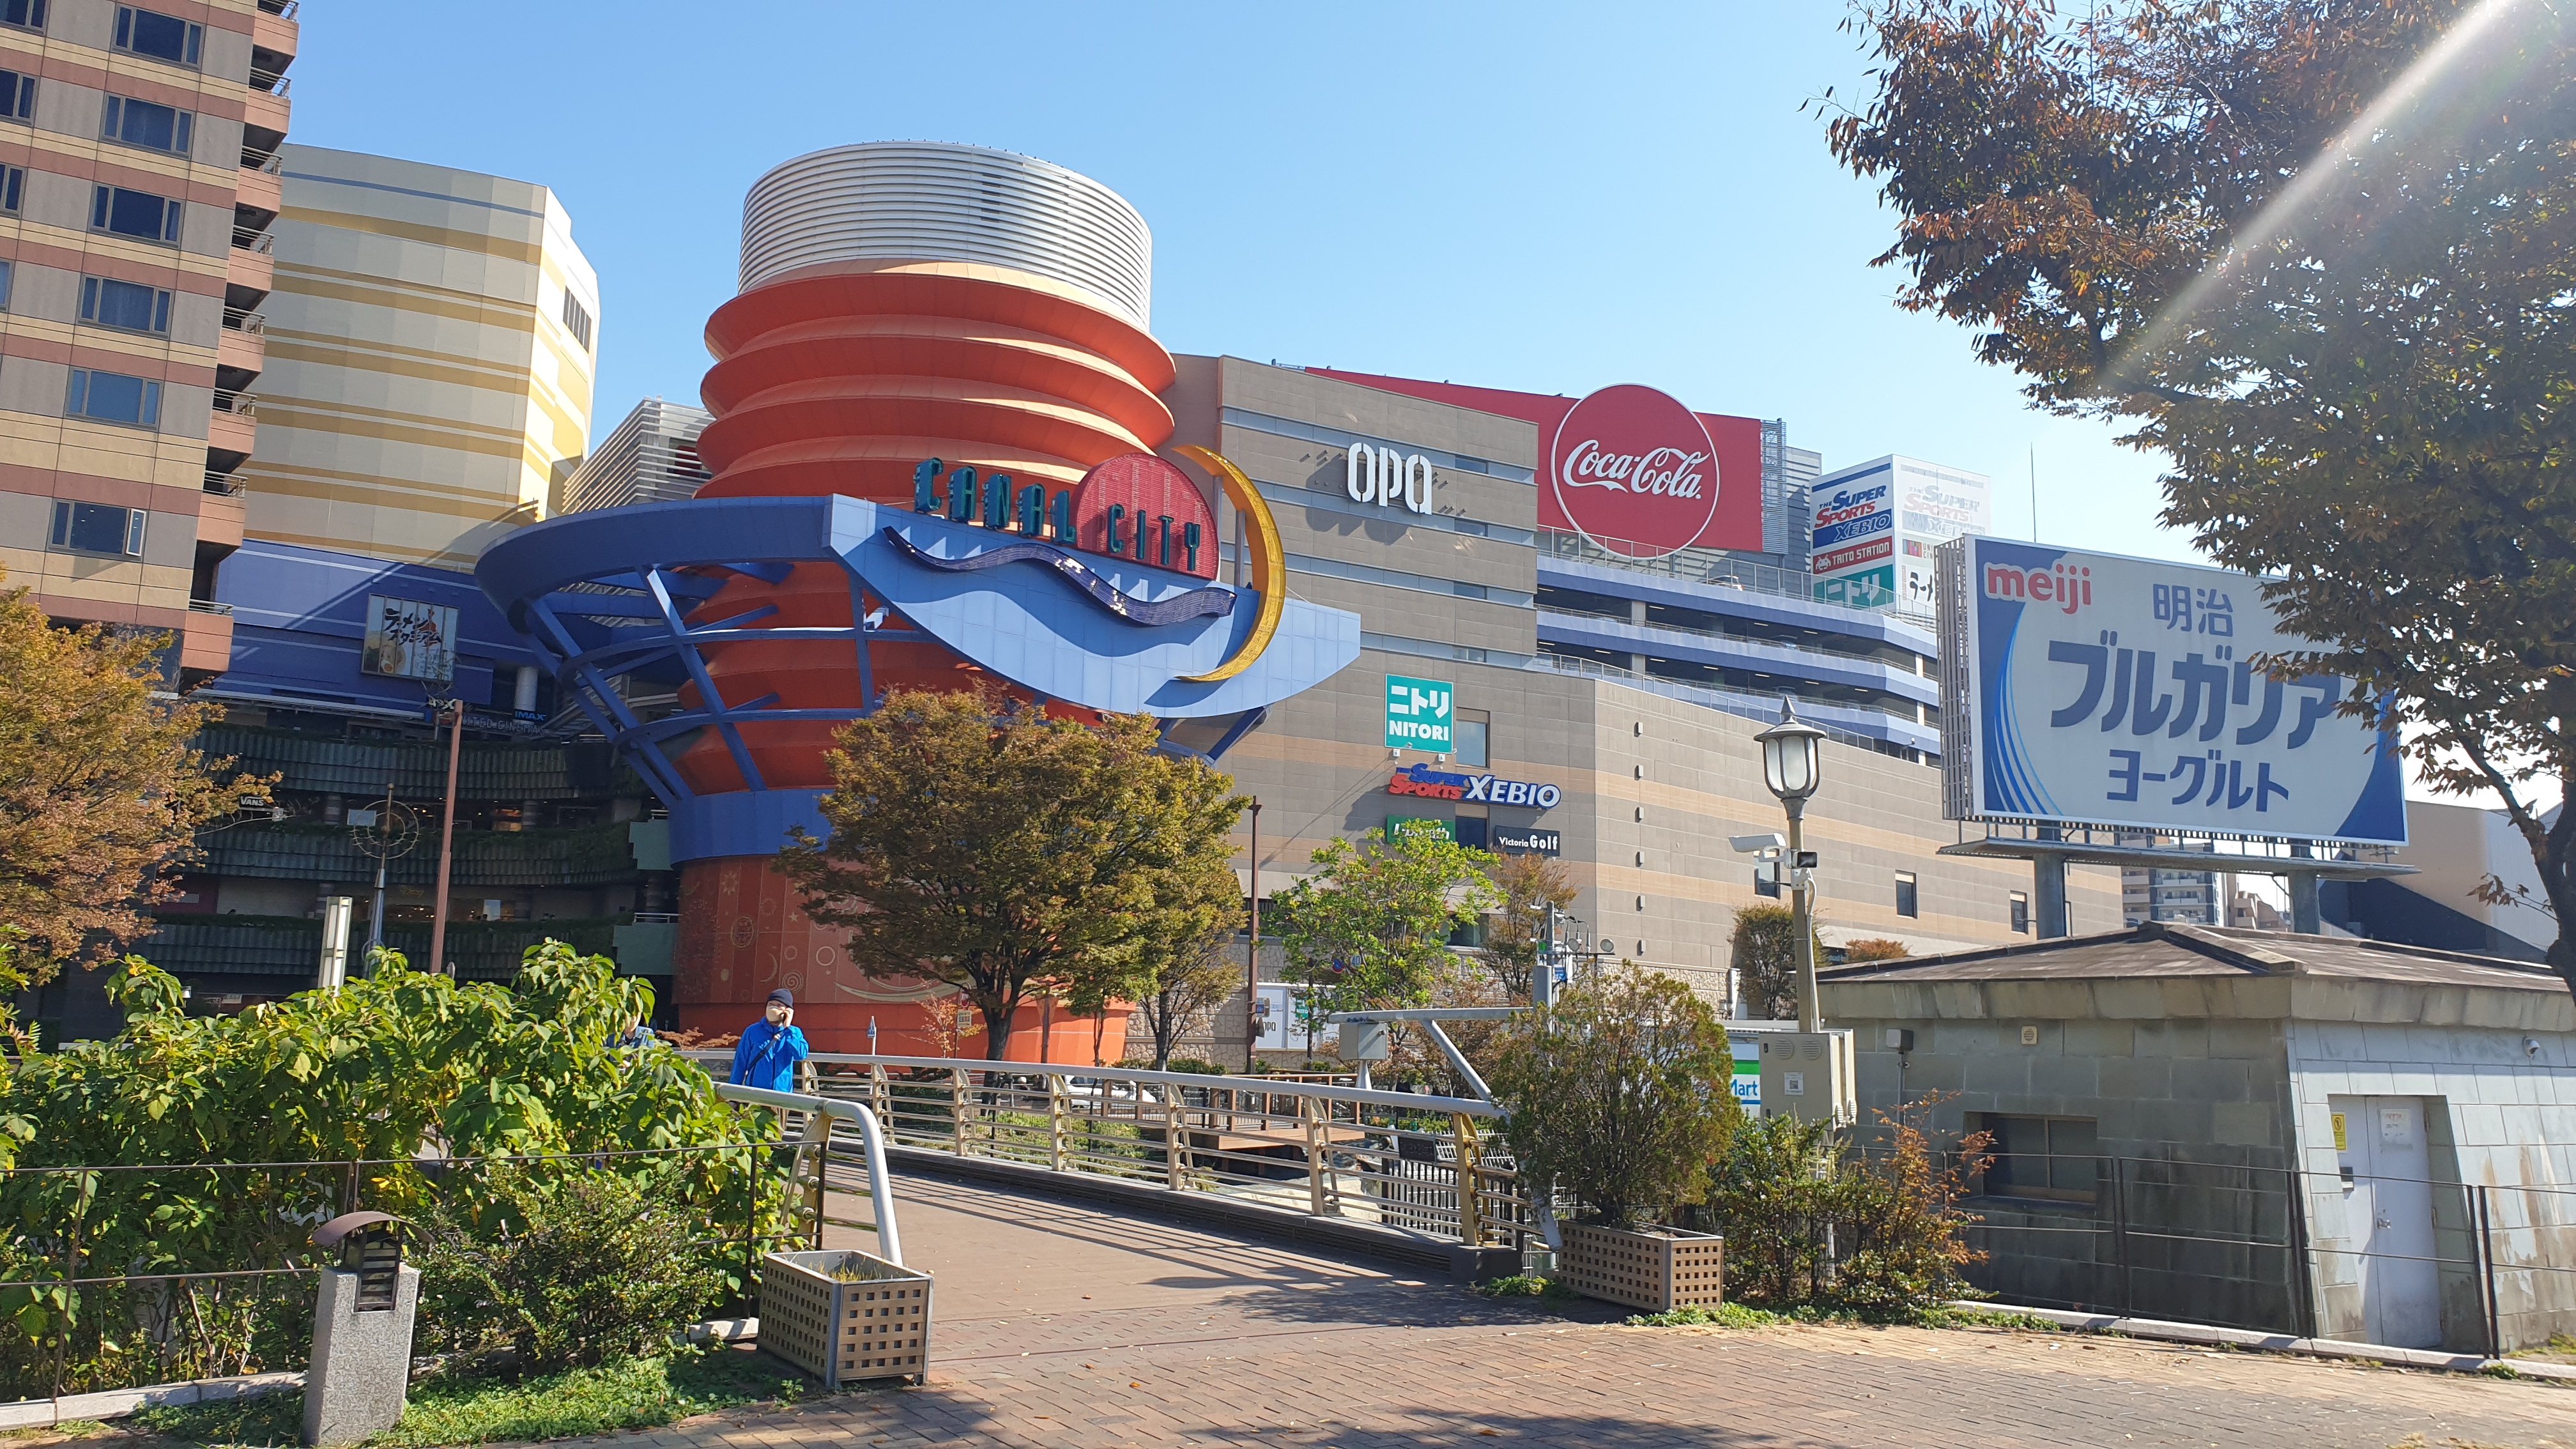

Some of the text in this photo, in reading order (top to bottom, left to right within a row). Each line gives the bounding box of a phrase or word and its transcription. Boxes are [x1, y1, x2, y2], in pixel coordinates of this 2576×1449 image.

[1563, 439, 1710, 500] Coca-Cola
[1820, 485, 1887, 511] THE SUPER
[1904, 493, 1969, 522] SPORTS
[1922, 485, 1980, 512] SUPER
[914, 456, 1200, 571] CANAL CITY
[1814, 501, 1876, 528] SPORTS
[1834, 514, 1890, 542] XEBIO
[1832, 542, 1890, 566] TAITO STATION
[1985, 562, 2092, 615] meiji
[2153, 583, 2234, 638] 明治
[1390, 685, 1449, 719] ニトリ
[2048, 630, 2342, 750] ブルガリア
[462, 714, 492, 728] NITED
[515, 710, 546, 721] IMAX
[1389, 720, 1449, 741] NITORI
[1388, 774, 1561, 808] SPORTS XEBIO
[2106, 749, 2289, 813] ヨーグルト
[240, 796, 264, 806] VANS
[1498, 834, 1558, 850] Victoria Golf
[1731, 1078, 1758, 1096] Mart
